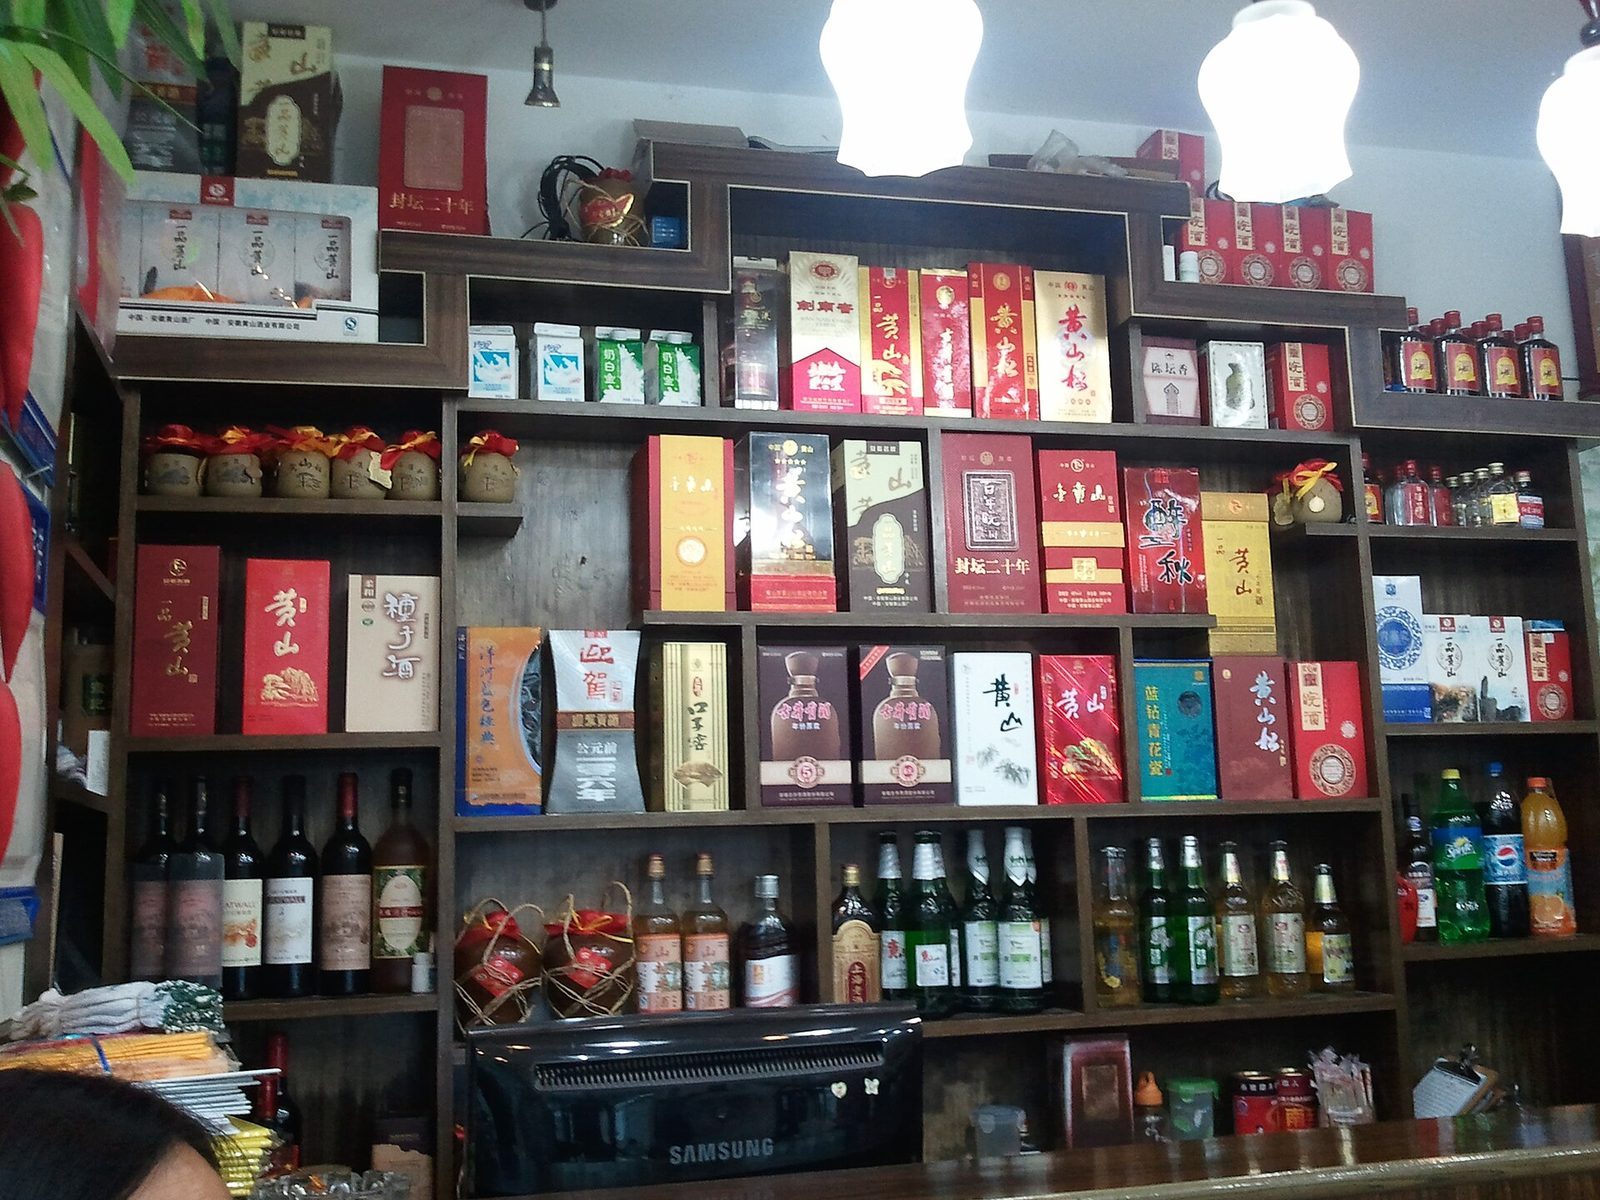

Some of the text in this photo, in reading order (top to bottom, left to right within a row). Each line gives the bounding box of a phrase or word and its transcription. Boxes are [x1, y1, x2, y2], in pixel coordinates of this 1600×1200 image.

[954, 557, 1031, 576] 封坛二十年
[687, 701, 709, 751] 口子窖
[669, 1137, 775, 1165] SAMSUNG
